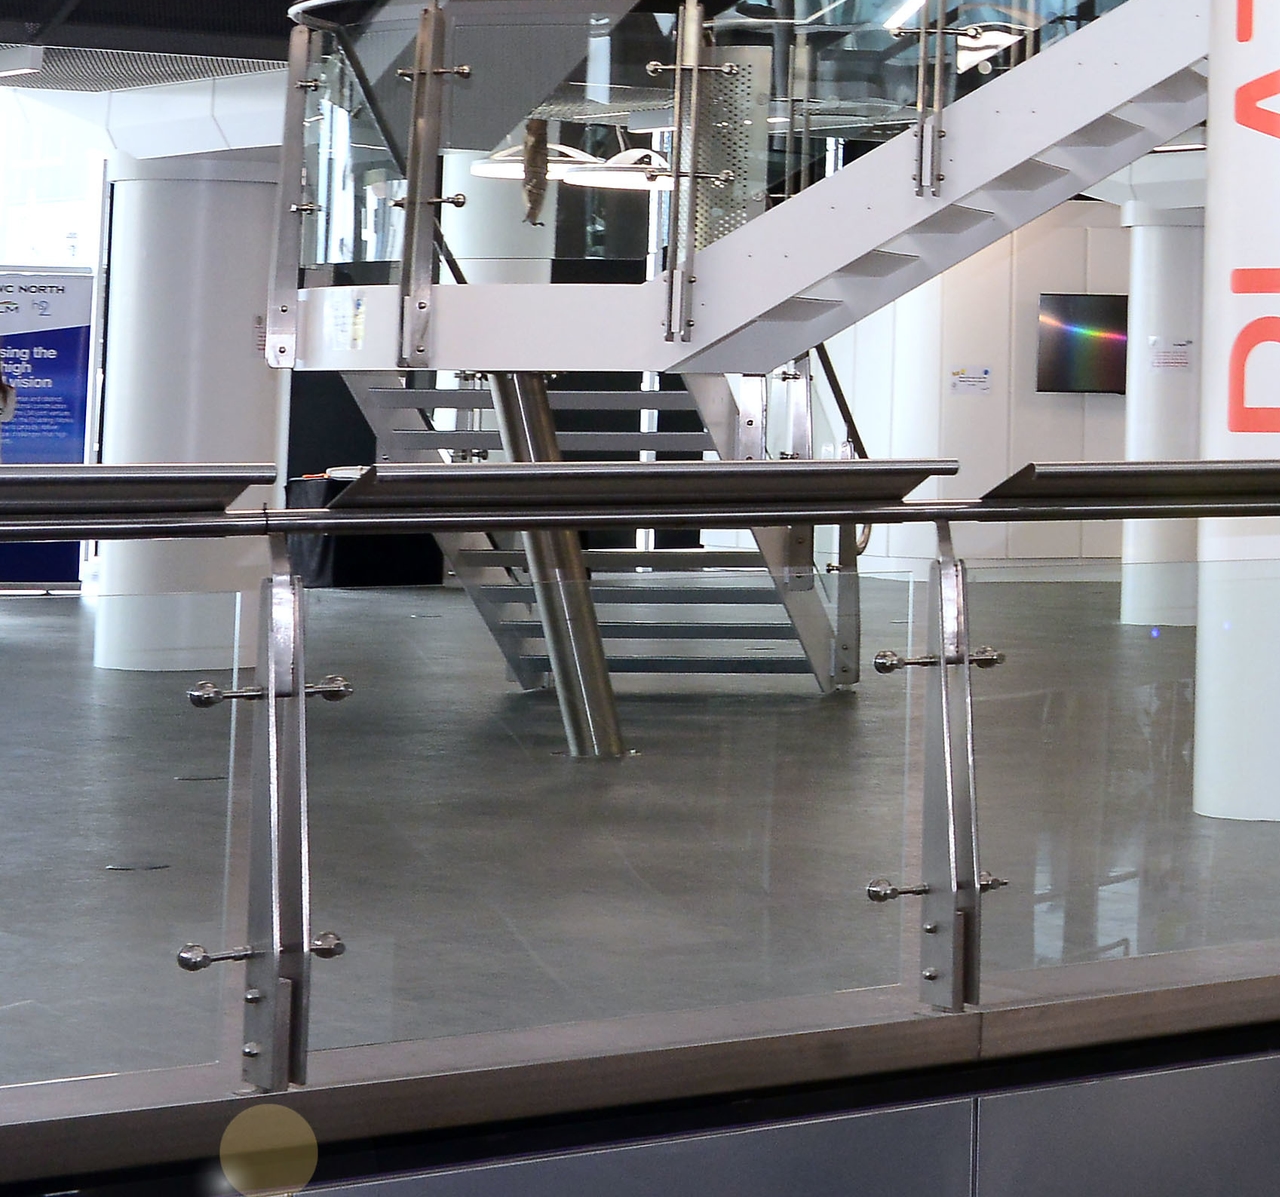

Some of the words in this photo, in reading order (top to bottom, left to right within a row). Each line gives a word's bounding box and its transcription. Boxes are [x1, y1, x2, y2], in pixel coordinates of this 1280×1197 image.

[18, 285, 66, 294] NORTH
[0, 347, 30, 361] sing
[33, 347, 58, 359] the
[1, 361, 32, 376] high
[10, 375, 53, 388] vision
